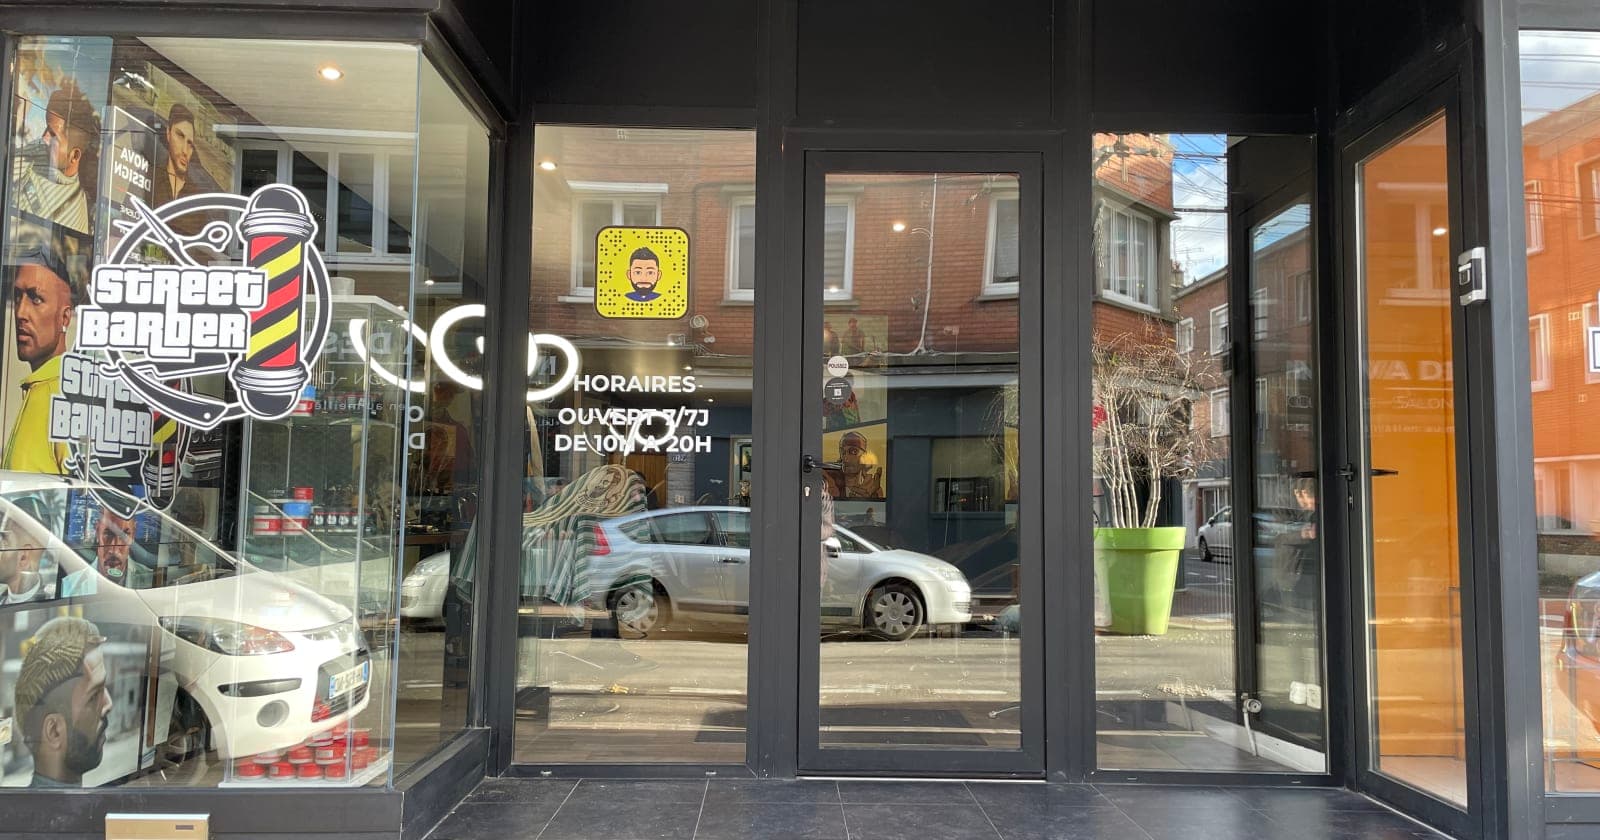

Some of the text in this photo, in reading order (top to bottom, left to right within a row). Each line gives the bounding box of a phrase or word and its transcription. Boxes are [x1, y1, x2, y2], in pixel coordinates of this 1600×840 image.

[573, 375, 697, 393] HORAIRES
[557, 406, 710, 428] OUVERT 7/7J
[554, 434, 588, 452] DE
[641, 435, 661, 452] A
[665, 435, 712, 453] 20H
